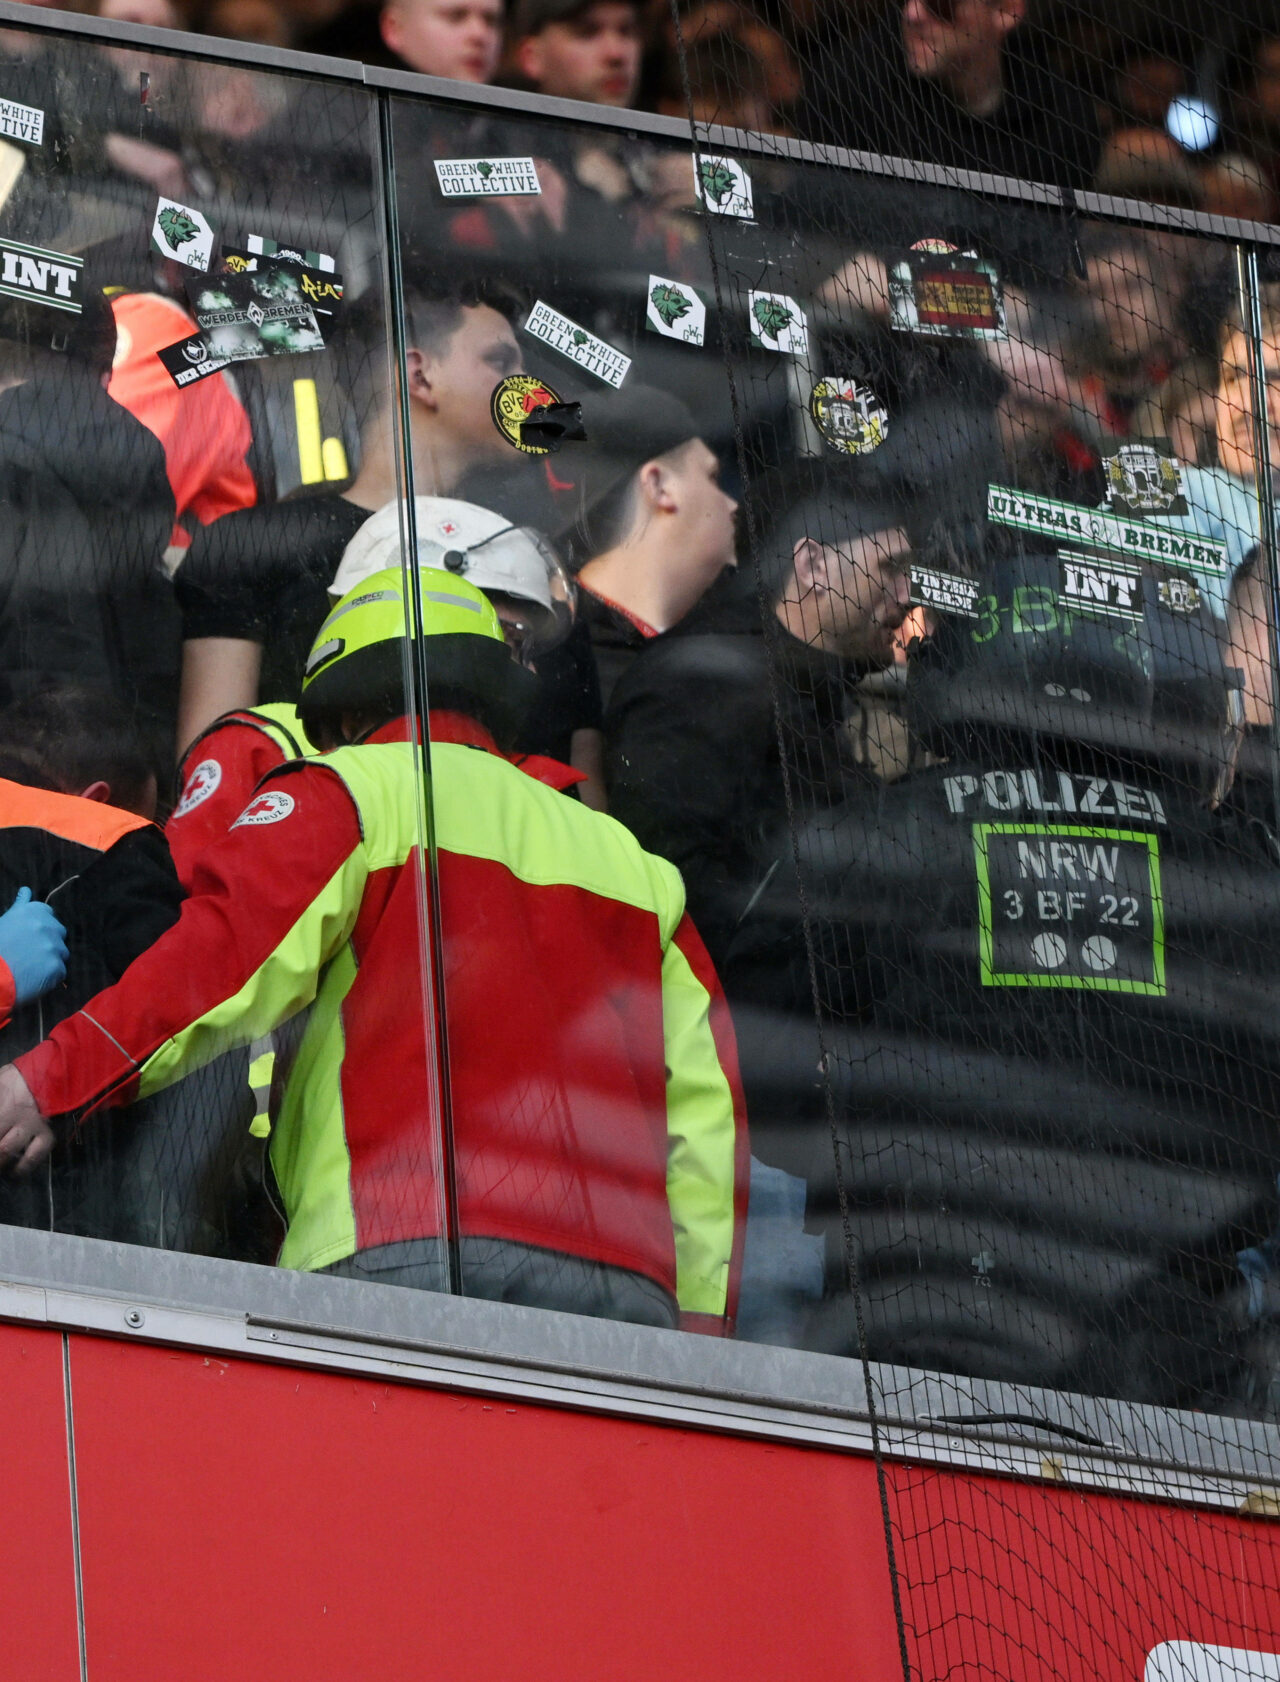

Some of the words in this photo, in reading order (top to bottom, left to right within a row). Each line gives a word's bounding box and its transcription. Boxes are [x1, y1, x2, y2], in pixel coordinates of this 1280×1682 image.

[0, 102, 41, 125] WHITE
[438, 163, 478, 176] GREEN
[492, 161, 533, 175] WHITE
[442, 175, 538, 194] COLLECTIVE
[1, 251, 77, 298] INT
[186, 248, 208, 272] GWC
[198, 311, 248, 329] WERDER
[264, 303, 313, 322] BREMEN
[535, 306, 575, 336] GREEN
[588, 339, 627, 371] WHITE
[683, 324, 703, 346] GWC
[528, 317, 622, 386] COLLECTIVE
[175, 367, 200, 386] DER
[992, 495, 1082, 533] ULTRAS
[1124, 527, 1222, 567] BREMEN
[1063, 563, 1137, 607] INT
[942, 768, 1168, 825] POLIZEI
[248, 810, 284, 822] KREUZ
[1017, 840, 1120, 884] NRW
[1003, 889, 1024, 920] 3
[1036, 890, 1087, 921] BF
[1099, 894, 1140, 927] 22
